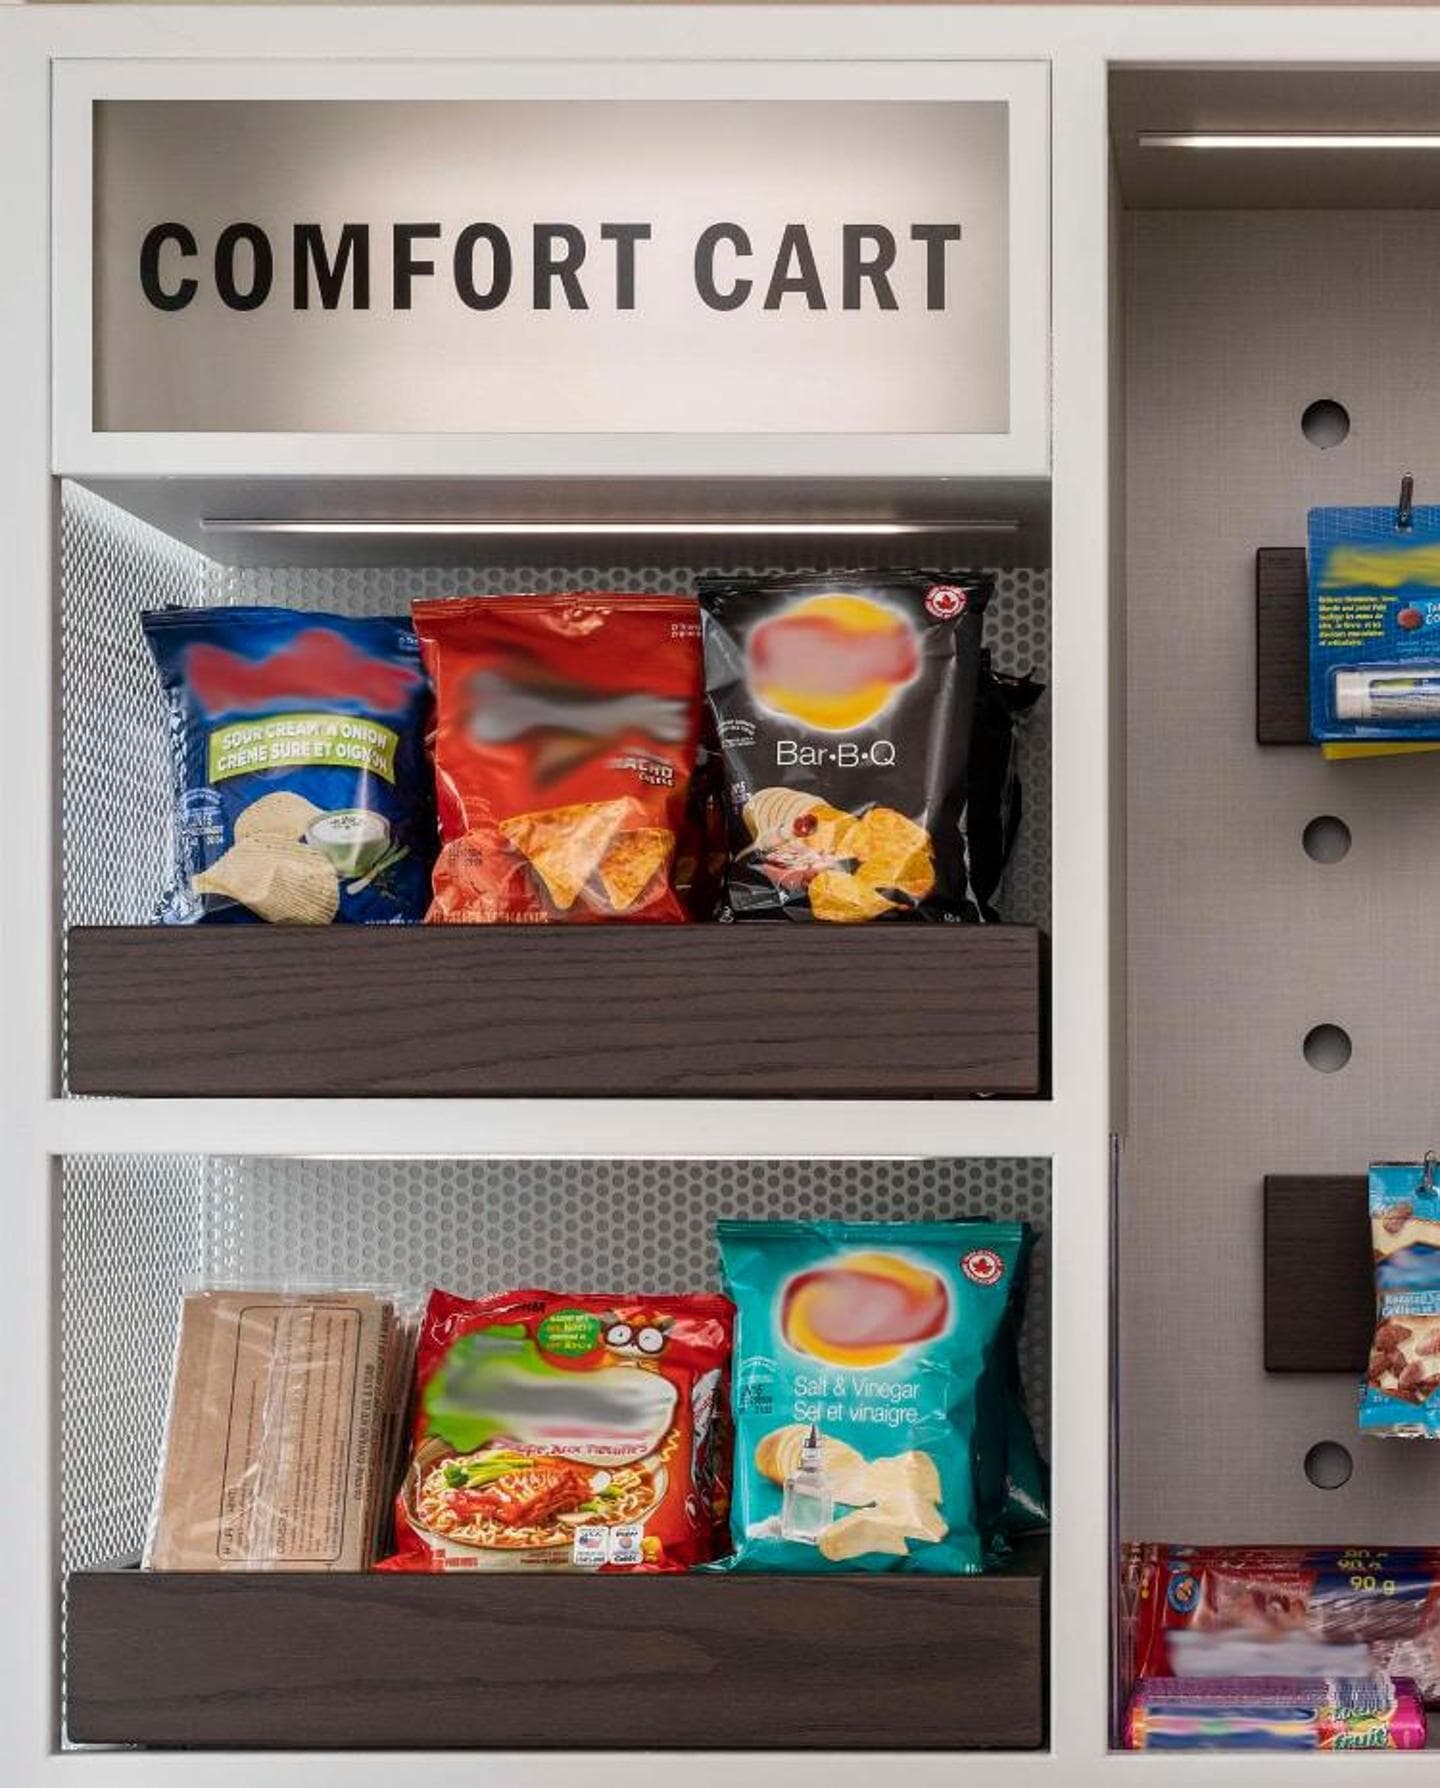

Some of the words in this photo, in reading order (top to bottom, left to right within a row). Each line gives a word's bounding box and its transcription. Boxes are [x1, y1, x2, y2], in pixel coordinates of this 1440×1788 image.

[139, 222, 651, 312] COMFORT
[692, 222, 961, 312] CART
[222, 728, 263, 750] SOUR
[265, 720, 321, 739] CREAM
[341, 723, 388, 750] ONION
[314, 741, 332, 757] ET
[794, 1375, 828, 1397] Salt
[833, 1375, 846, 1397] &
[852, 1375, 920, 1403] Vinegar
[794, 1400, 820, 1421] Sel
[827, 1402, 843, 1421] et
[849, 1403, 919, 1428] vinaigre
[1350, 1576, 1376, 1591] 90
[1382, 1579, 1396, 1595] g
